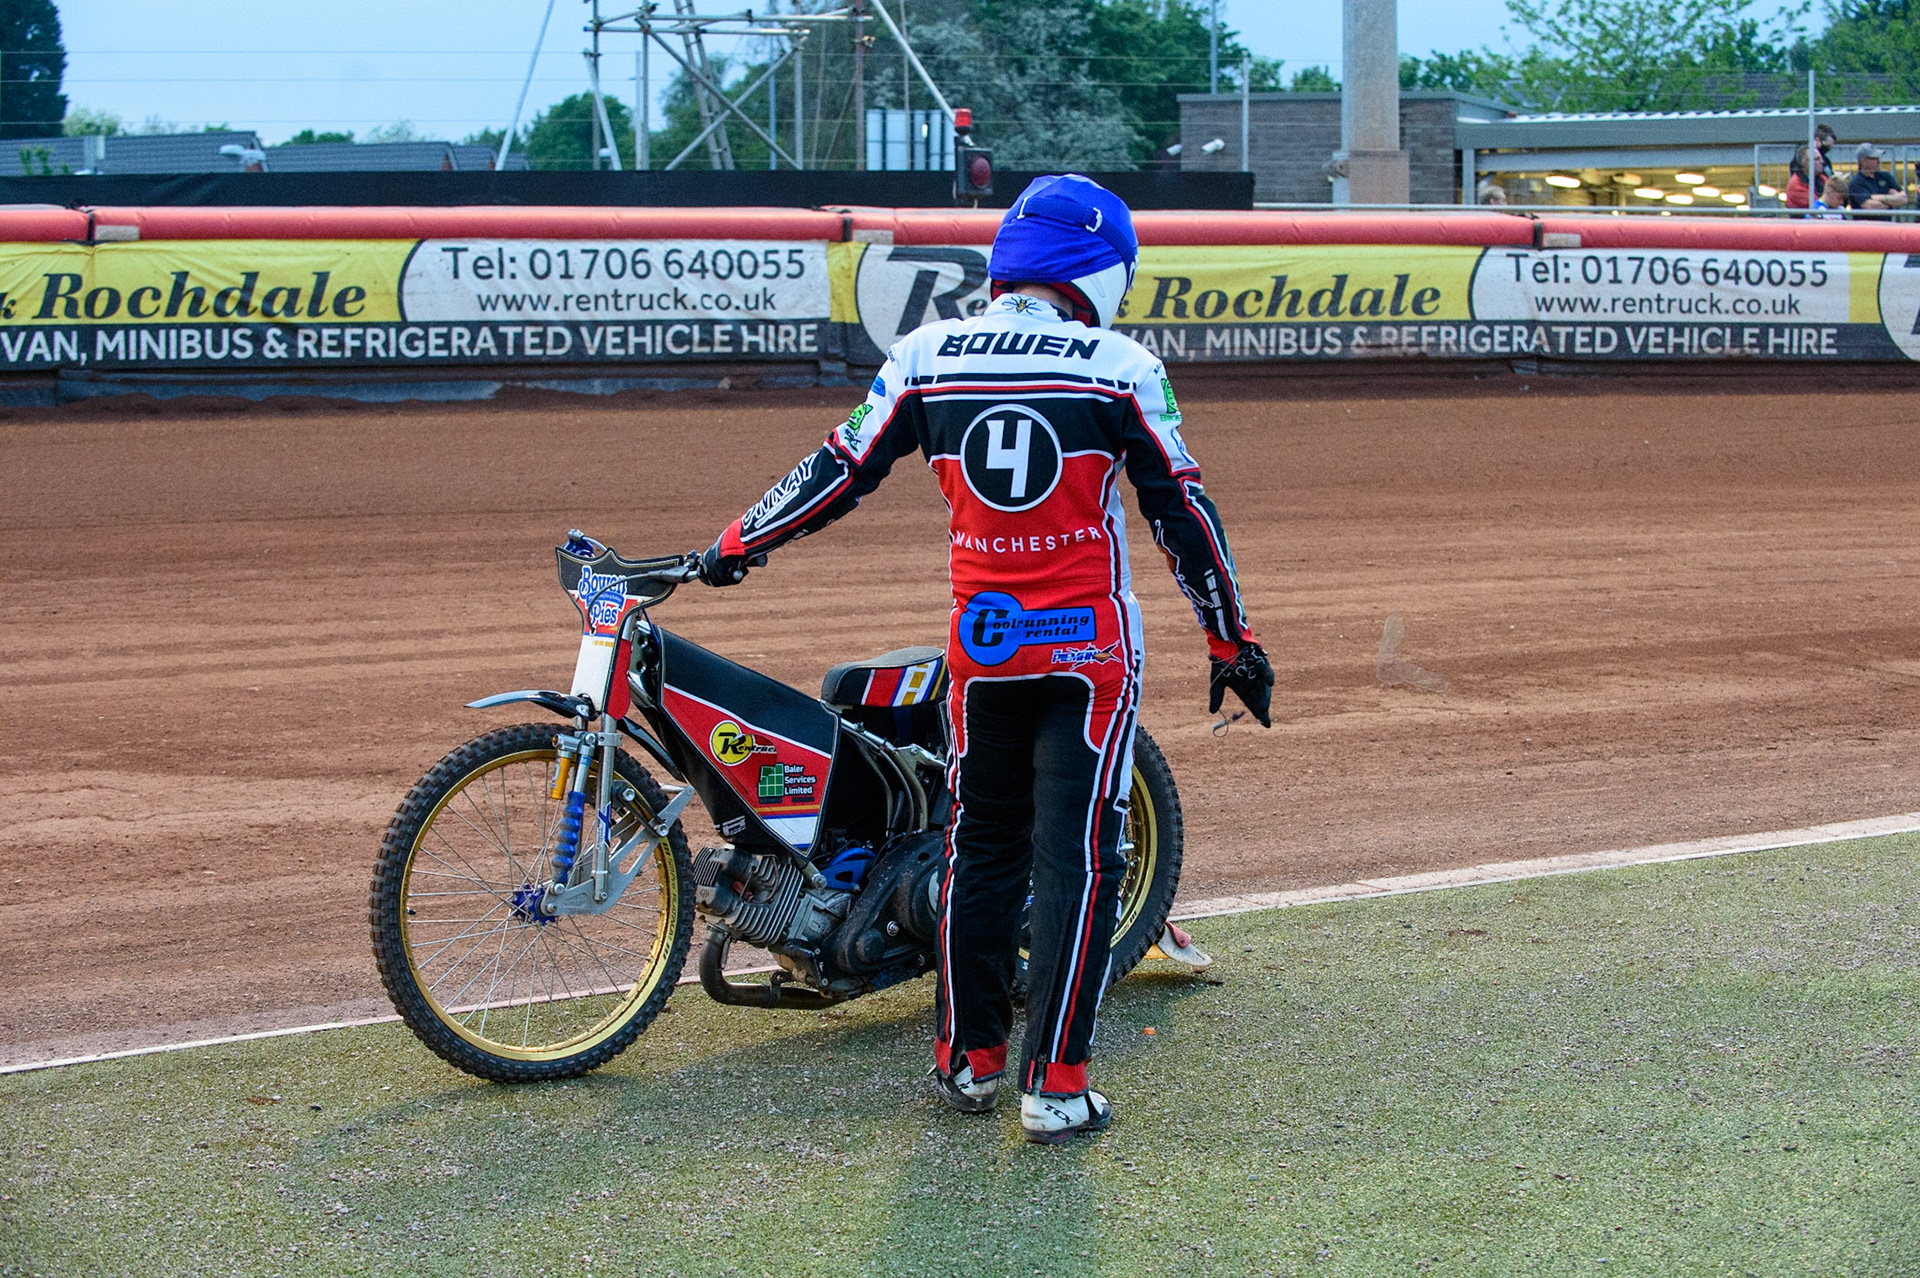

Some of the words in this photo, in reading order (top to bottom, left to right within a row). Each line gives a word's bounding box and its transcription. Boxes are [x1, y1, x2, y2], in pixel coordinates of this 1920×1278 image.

[441, 246, 517, 280] Tel:
[529, 248, 652, 280] 01706
[664, 249, 806, 279] 640055
[1506, 253, 1571, 284] Tel:
[1581, 254, 1691, 285] 01706
[1701, 258, 1828, 287] 640055
[32, 271, 366, 320] Rochdale
[477, 287, 776, 312] www.rentruck.co.uk
[1144, 273, 1441, 320] Rochdale
[1534, 292, 1800, 316] www.rentruck.co.uk
[1, 329, 88, 365] VAN,
[95, 328, 254, 361] MINIBUS
[262, 328, 289, 359] &
[297, 325, 573, 359] REFRIGERATED
[579, 324, 733, 356] VEHICLE
[740, 323, 819, 353] HIRE
[937, 330, 1101, 361] BOWEN
[1205, 327, 1343, 357] MINIBUS
[1350, 327, 1375, 355] &
[1382, 325, 1618, 354] REFRIGERATED
[1625, 326, 1760, 354] VEHICLE
[1767, 328, 1838, 355] HIRE
[985, 419, 1033, 498] 4
[952, 526, 1102, 553] MANCHESTER
[578, 565, 627, 600] Bowen
[590, 600, 619, 627] Pies
[972, 608, 1090, 647] Coolrunning
[1025, 625, 1078, 639] rental
[784, 765, 804, 774] Baler
[784, 775, 816, 784] Services
[784, 786, 813, 795] Limited
